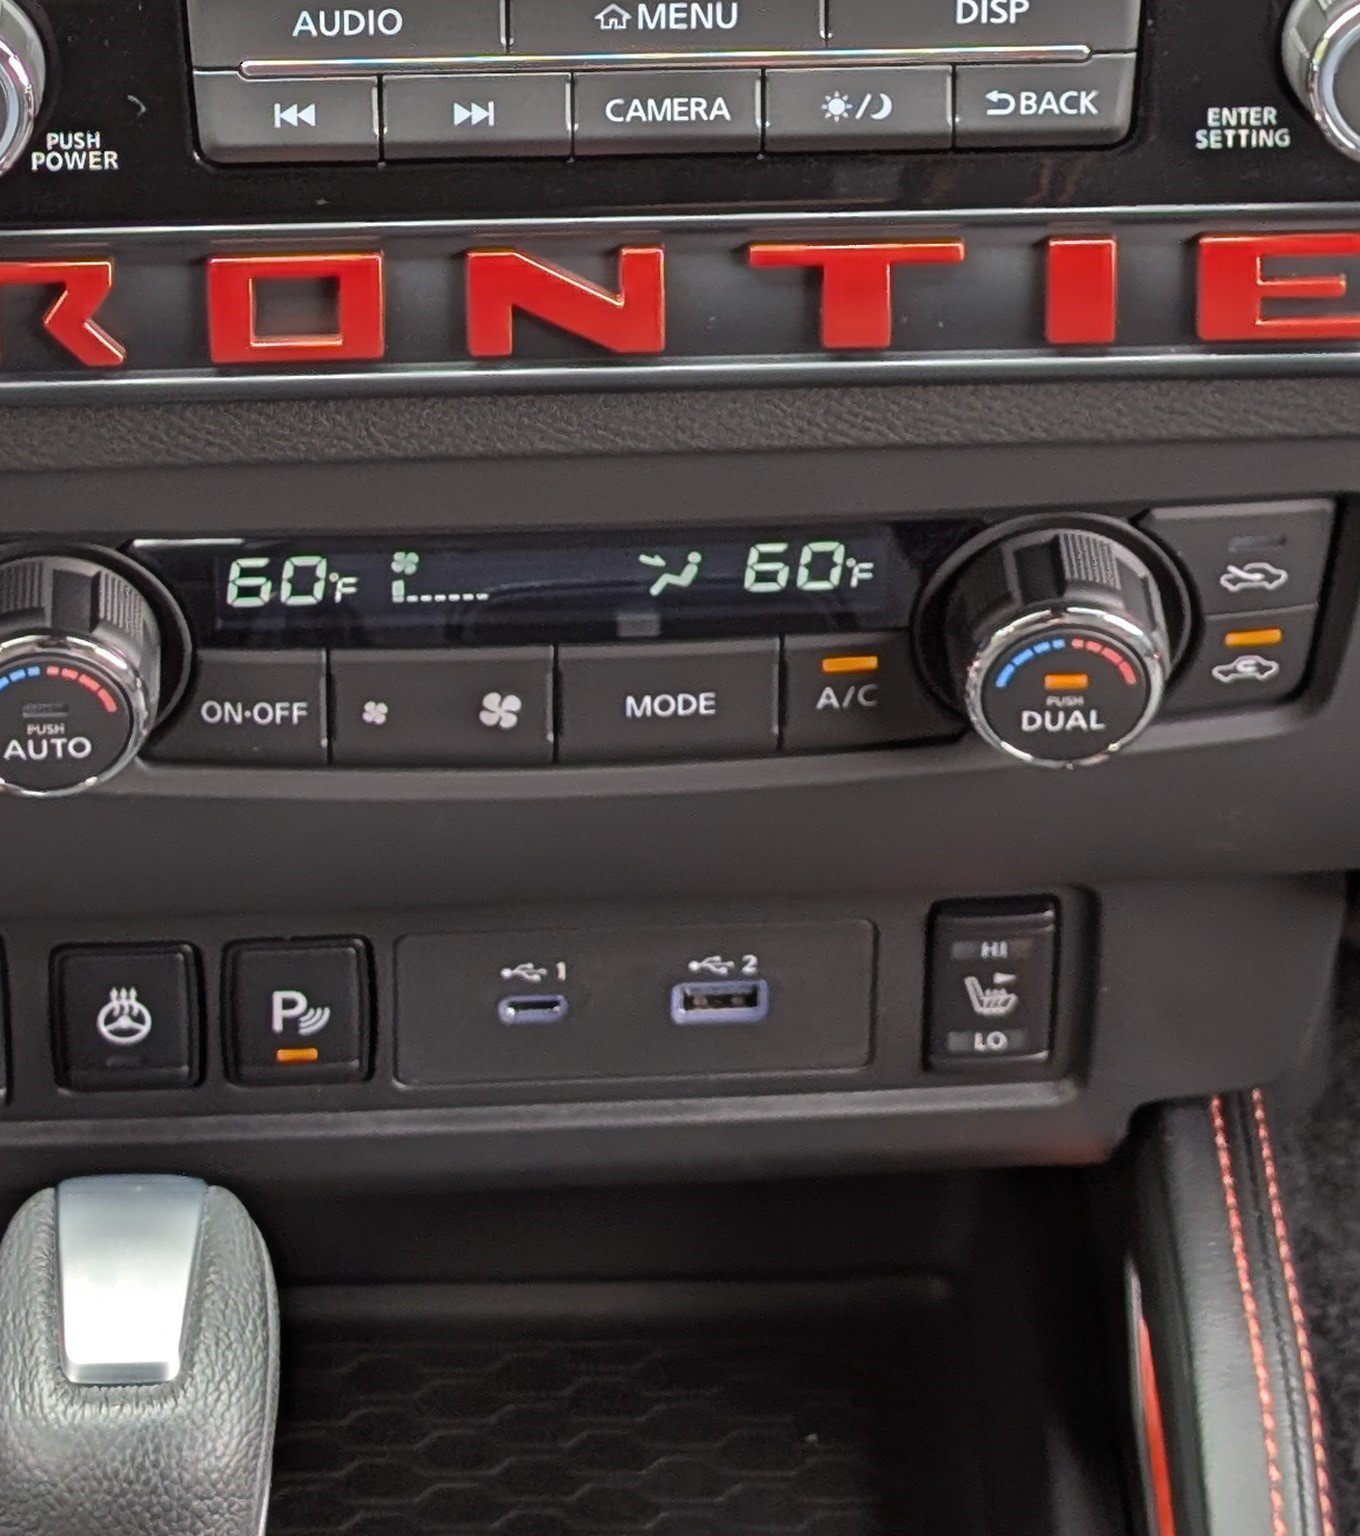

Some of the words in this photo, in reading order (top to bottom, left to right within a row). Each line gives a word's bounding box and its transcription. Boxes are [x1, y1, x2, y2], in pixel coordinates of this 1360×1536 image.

[291, 7, 404, 40] AUDIO
[636, 0, 740, 32] MENU
[605, 93, 731, 124] CAMERA
[1020, 89, 1100, 119] BACK
[1206, 107, 1279, 130] ENTER
[46, 131, 102, 152] PUSH
[1194, 123, 1292, 150] SETTING
[30, 150, 120, 173] POWER
[625, 692, 717, 718] MODE
[816, 686, 879, 710] A/C
[1046, 695, 1085, 707] PUSH
[26, 723, 66, 737] PUSH
[1020, 710, 1106, 733] DUAL
[2, 736, 93, 762] AUTO
[980, 941, 1008, 958] HI
[556, 964, 567, 980] 1
[742, 955, 758, 975] 2
[974, 1033, 1006, 1049] LO
